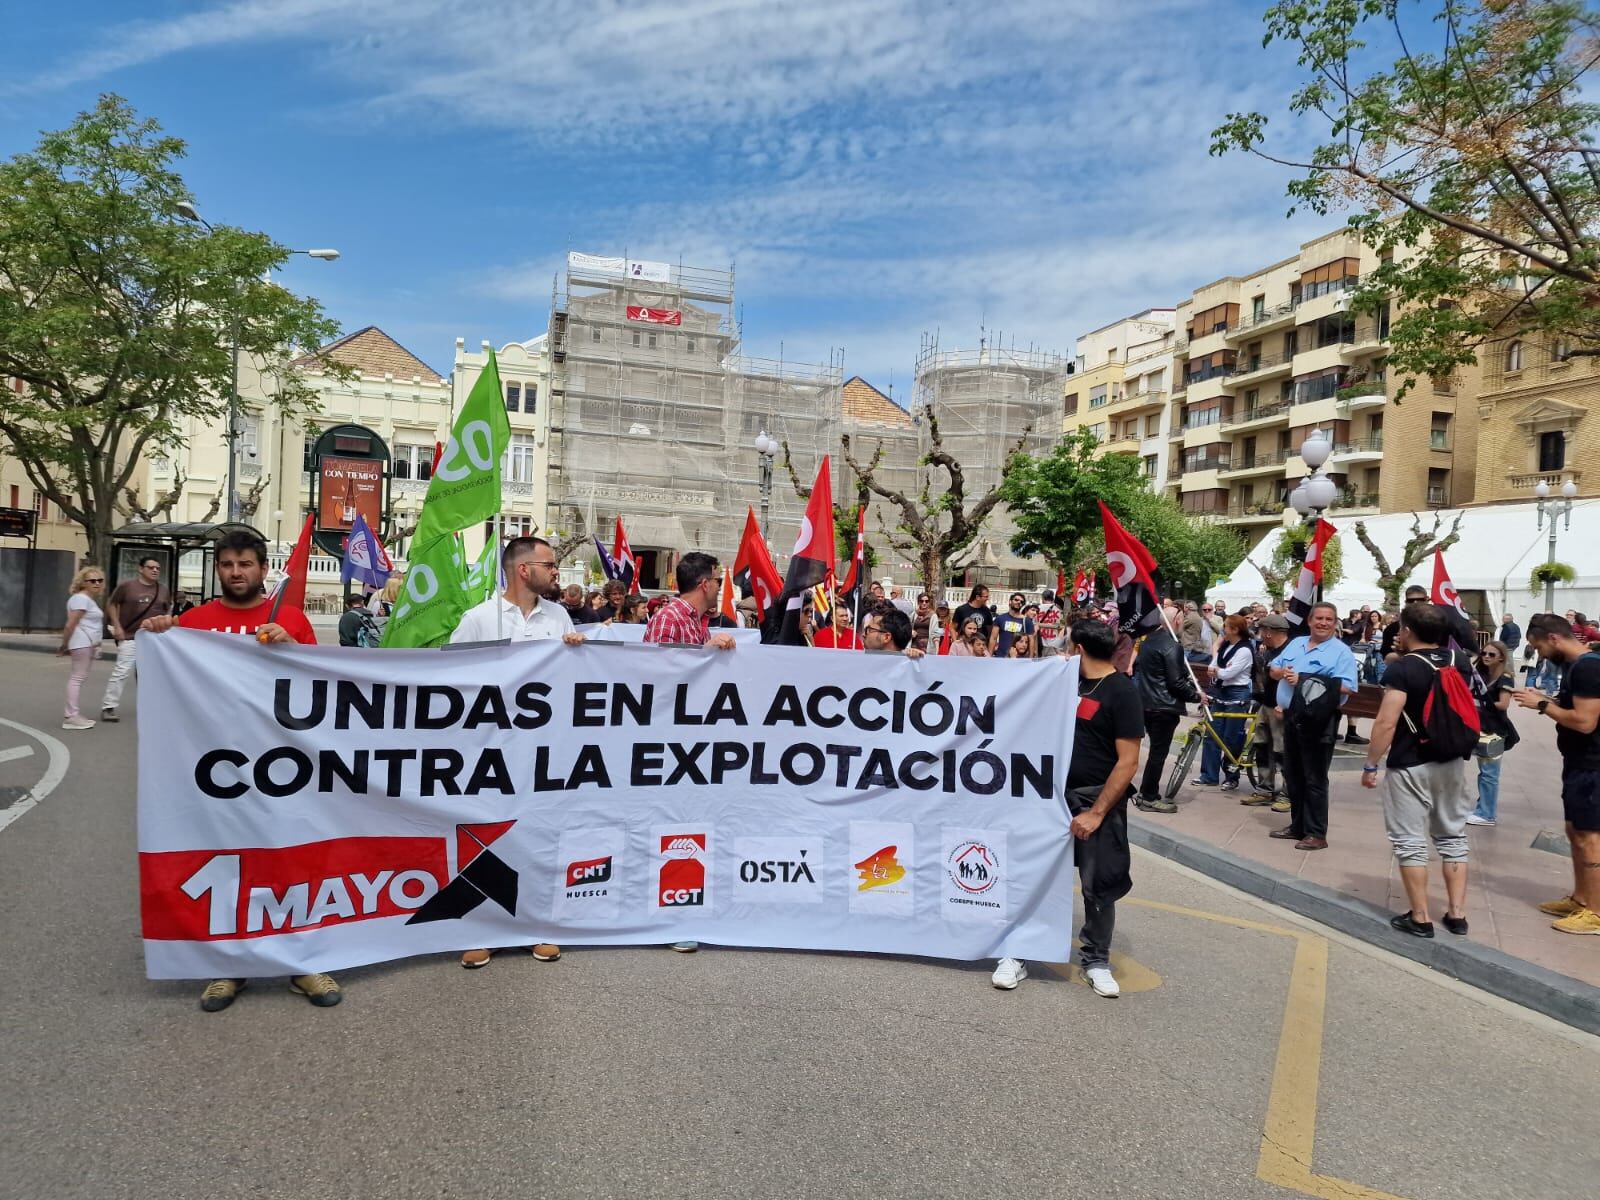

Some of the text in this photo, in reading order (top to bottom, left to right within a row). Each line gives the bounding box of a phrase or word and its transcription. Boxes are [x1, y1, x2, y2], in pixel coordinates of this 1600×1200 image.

[325, 469, 379, 481] CON TIEMPO
[274, 678, 996, 736] UNIDAS EN LA ACCIÓN
[195, 738, 1054, 799] CONTRA LA EXPLOTACIÓN
[572, 863, 607, 880] CNT
[180, 854, 439, 936] 1 MAYO
[566, 889, 608, 899] HUESCA
[661, 888, 703, 905] CGT
